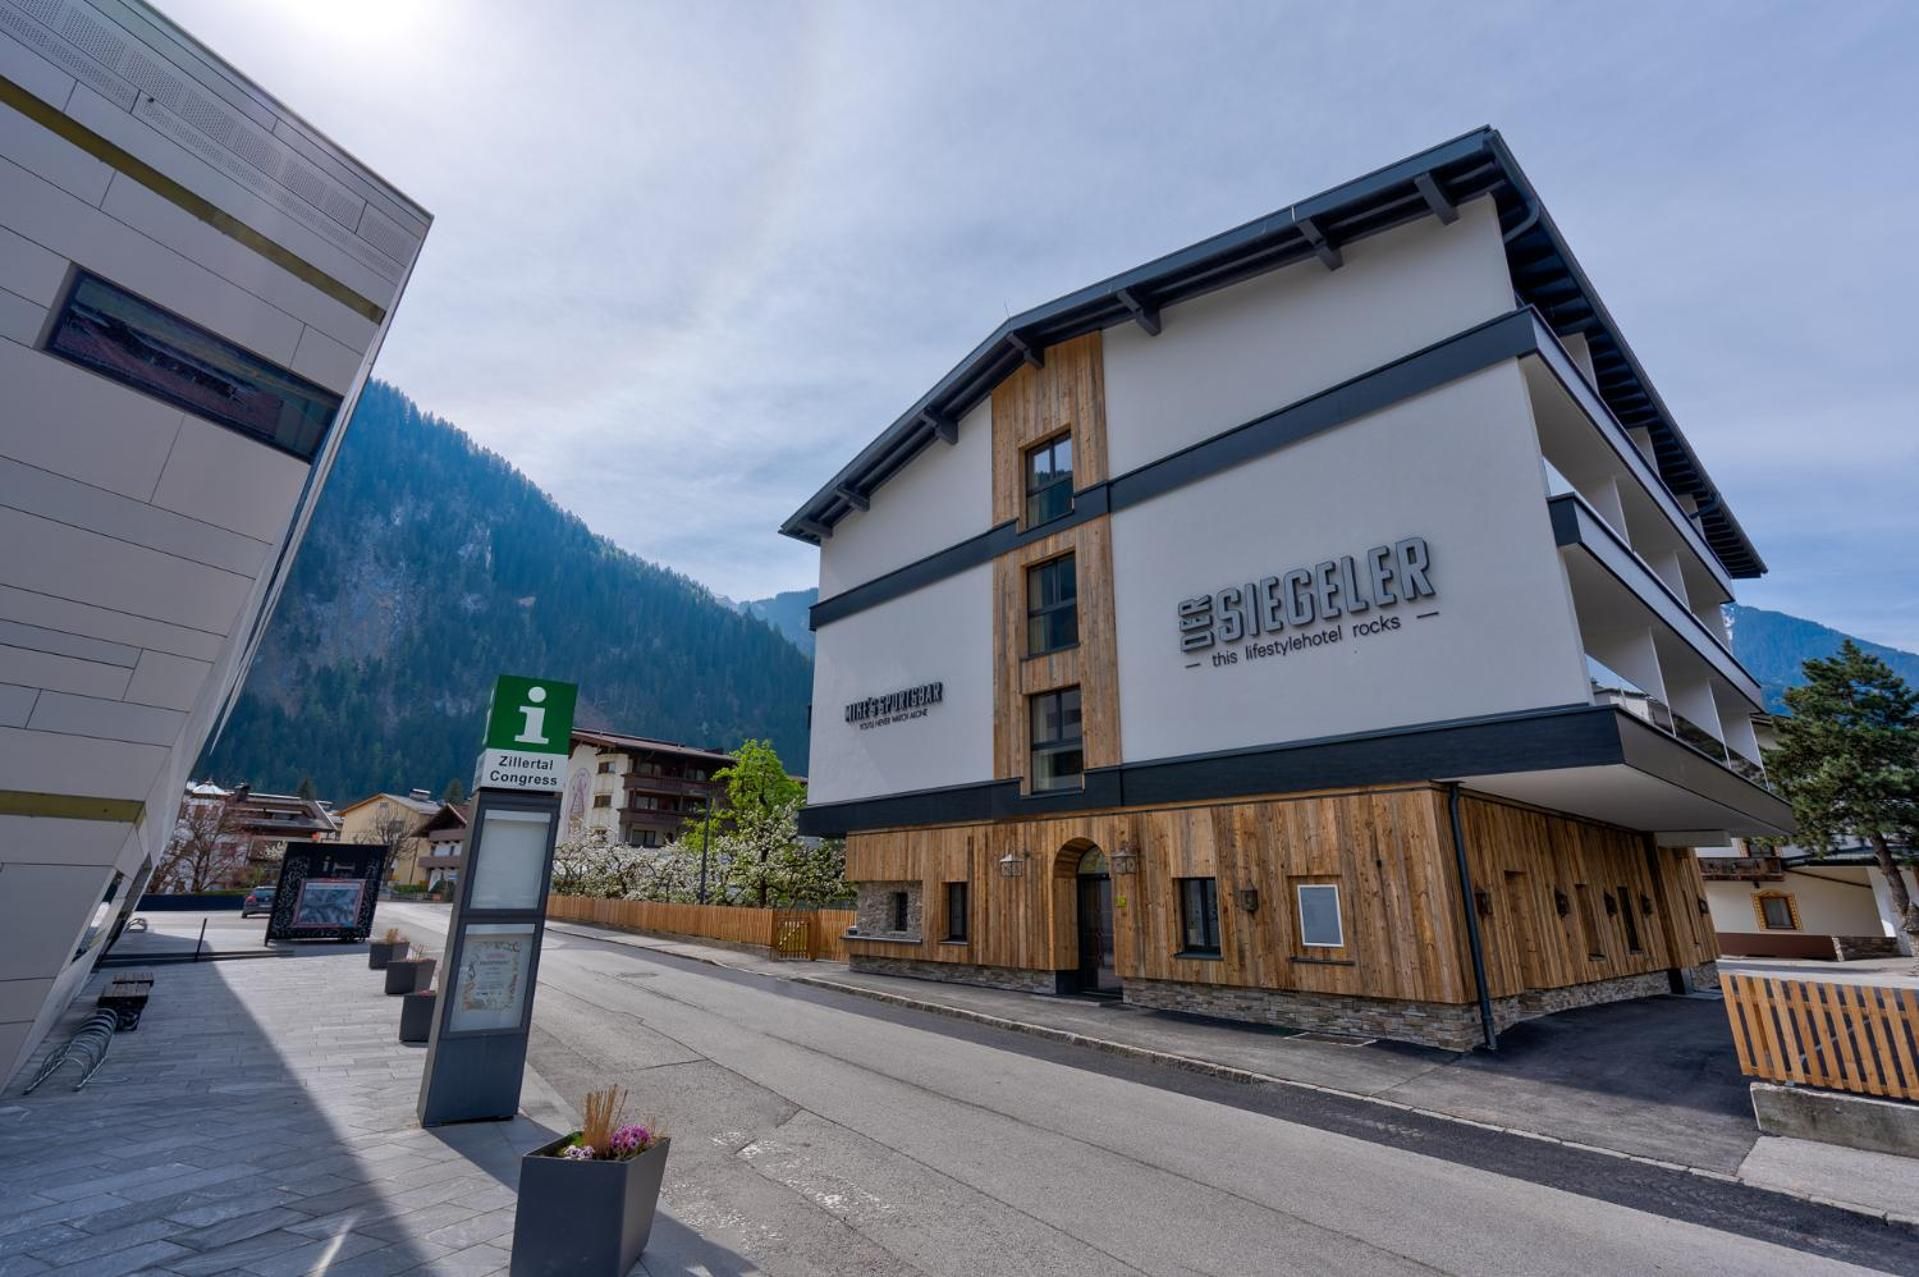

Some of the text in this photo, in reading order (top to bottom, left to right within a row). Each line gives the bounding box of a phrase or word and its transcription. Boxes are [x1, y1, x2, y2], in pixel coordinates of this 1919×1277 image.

[1215, 536, 1436, 643] SIEGELER
[1178, 594, 1214, 653] DER
[1212, 615, 1401, 668] this lifestylehotel rocks
[490, 770, 558, 786] Congress
[499, 755, 554, 771] Zillertal
